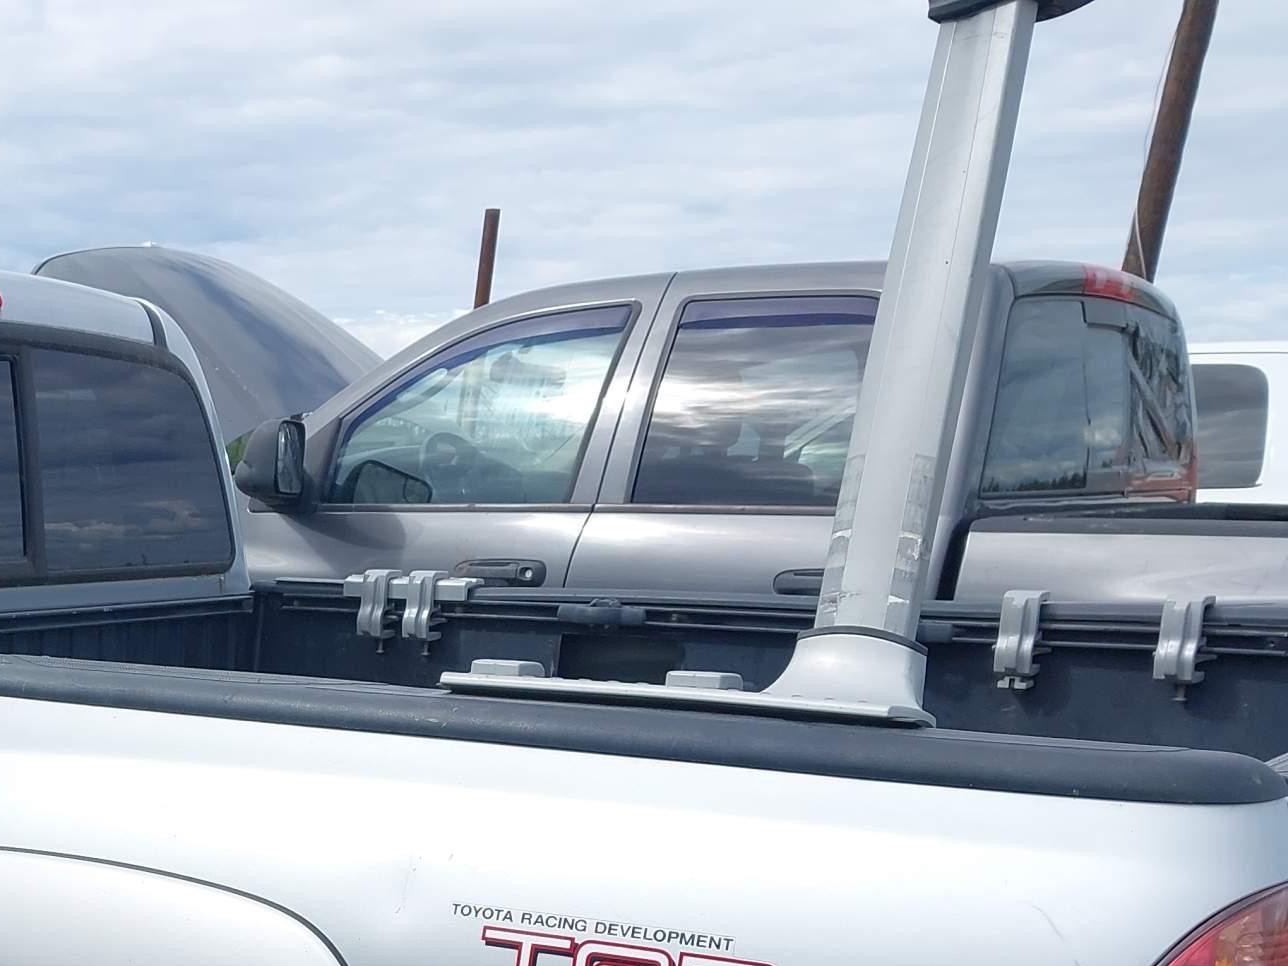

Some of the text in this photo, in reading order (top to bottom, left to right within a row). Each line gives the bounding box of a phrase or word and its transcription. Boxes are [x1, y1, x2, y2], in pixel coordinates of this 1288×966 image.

[452, 903, 734, 951] TOYOTA RACING DEVELOPMENT
